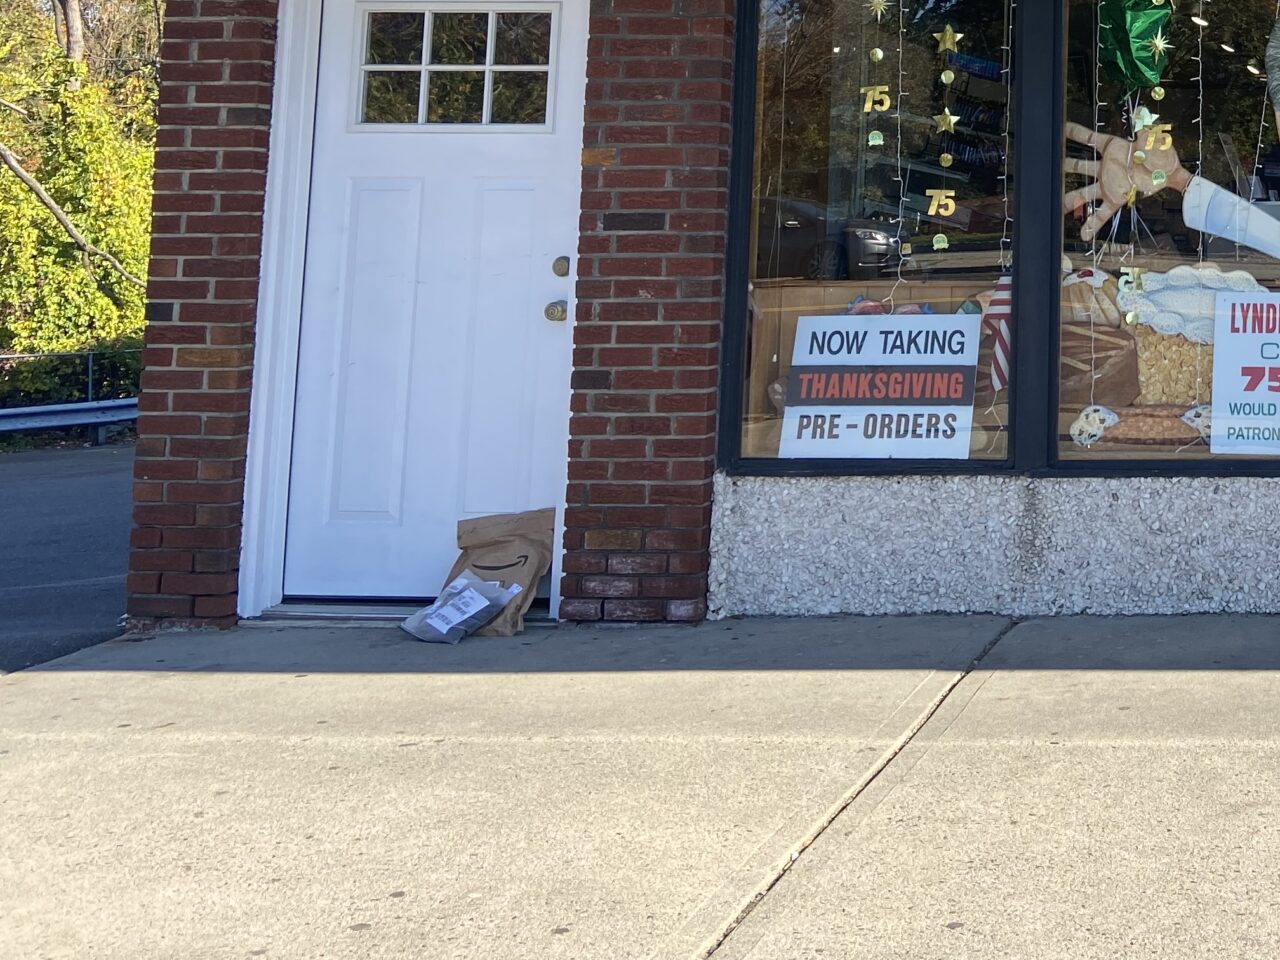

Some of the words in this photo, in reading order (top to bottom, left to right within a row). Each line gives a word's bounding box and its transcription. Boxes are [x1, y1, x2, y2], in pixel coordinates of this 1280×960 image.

[860, 85, 891, 112] 75
[925, 189, 956, 217] 75
[809, 331, 868, 355] NOW
[879, 330, 965, 355] TAKING
[800, 373, 964, 400] THANKSGIVING
[1229, 403, 1277, 416] WOULD
